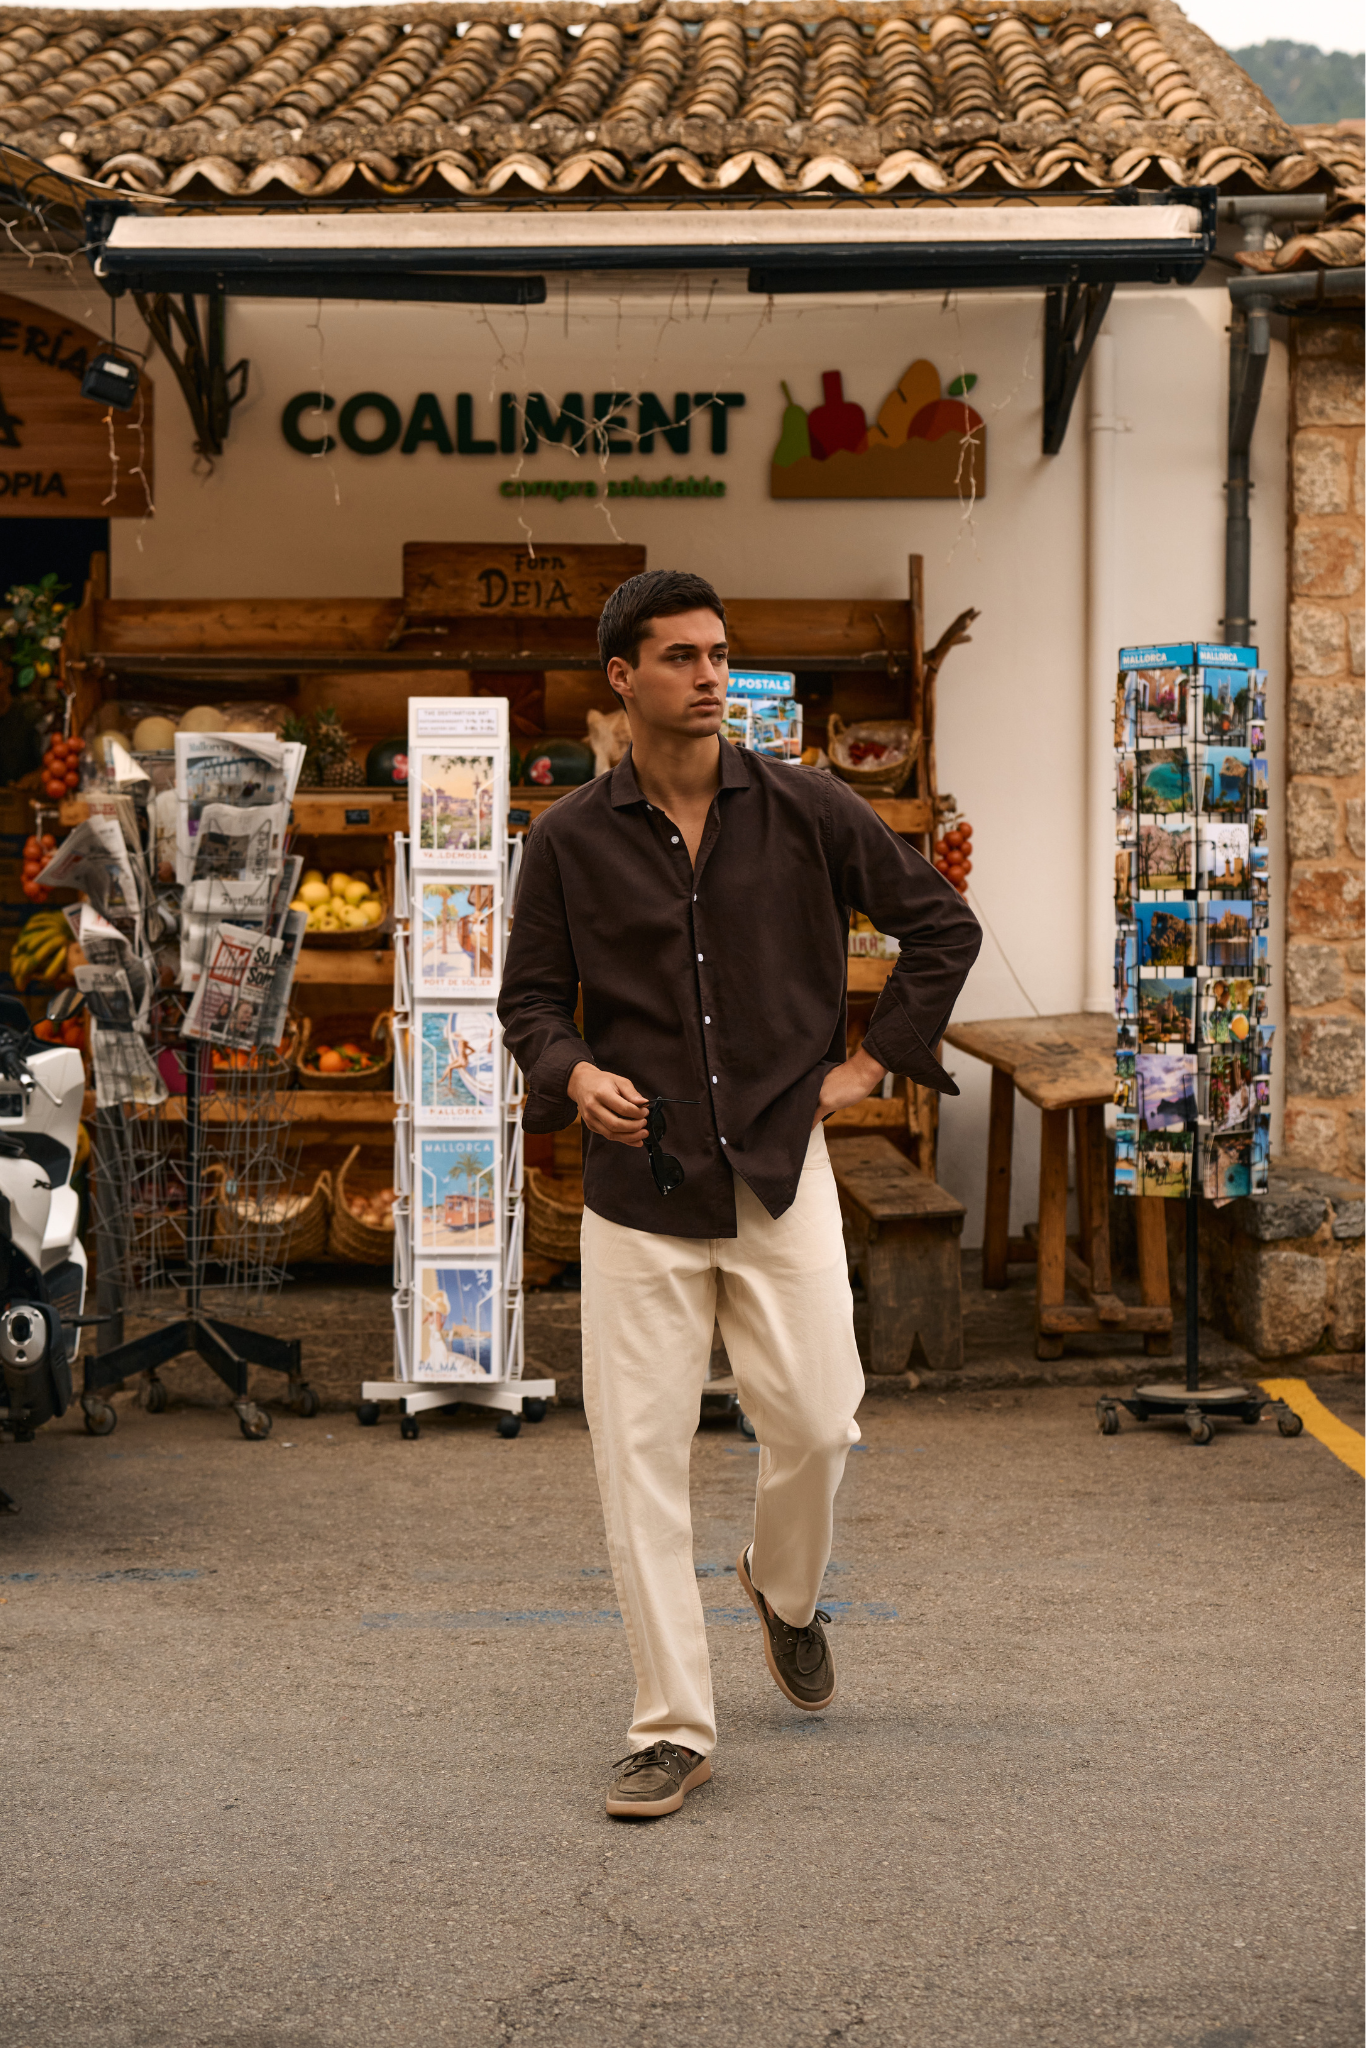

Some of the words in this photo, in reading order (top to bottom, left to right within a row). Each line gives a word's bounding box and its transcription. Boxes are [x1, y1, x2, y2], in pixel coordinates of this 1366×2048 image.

[281, 391, 746, 456] COALIMENT
[501, 480, 597, 501] compra
[607, 475, 726, 497] saludable
[1122, 653, 1167, 664] MALLORCA
[1199, 651, 1238, 662] MALLORCA
[738, 677, 791, 690] POSTALS
[423, 851, 488, 859] VALDEMOSSA
[424, 1142, 491, 1153] MALLORCA
[418, 1359, 457, 1373] PAMA
